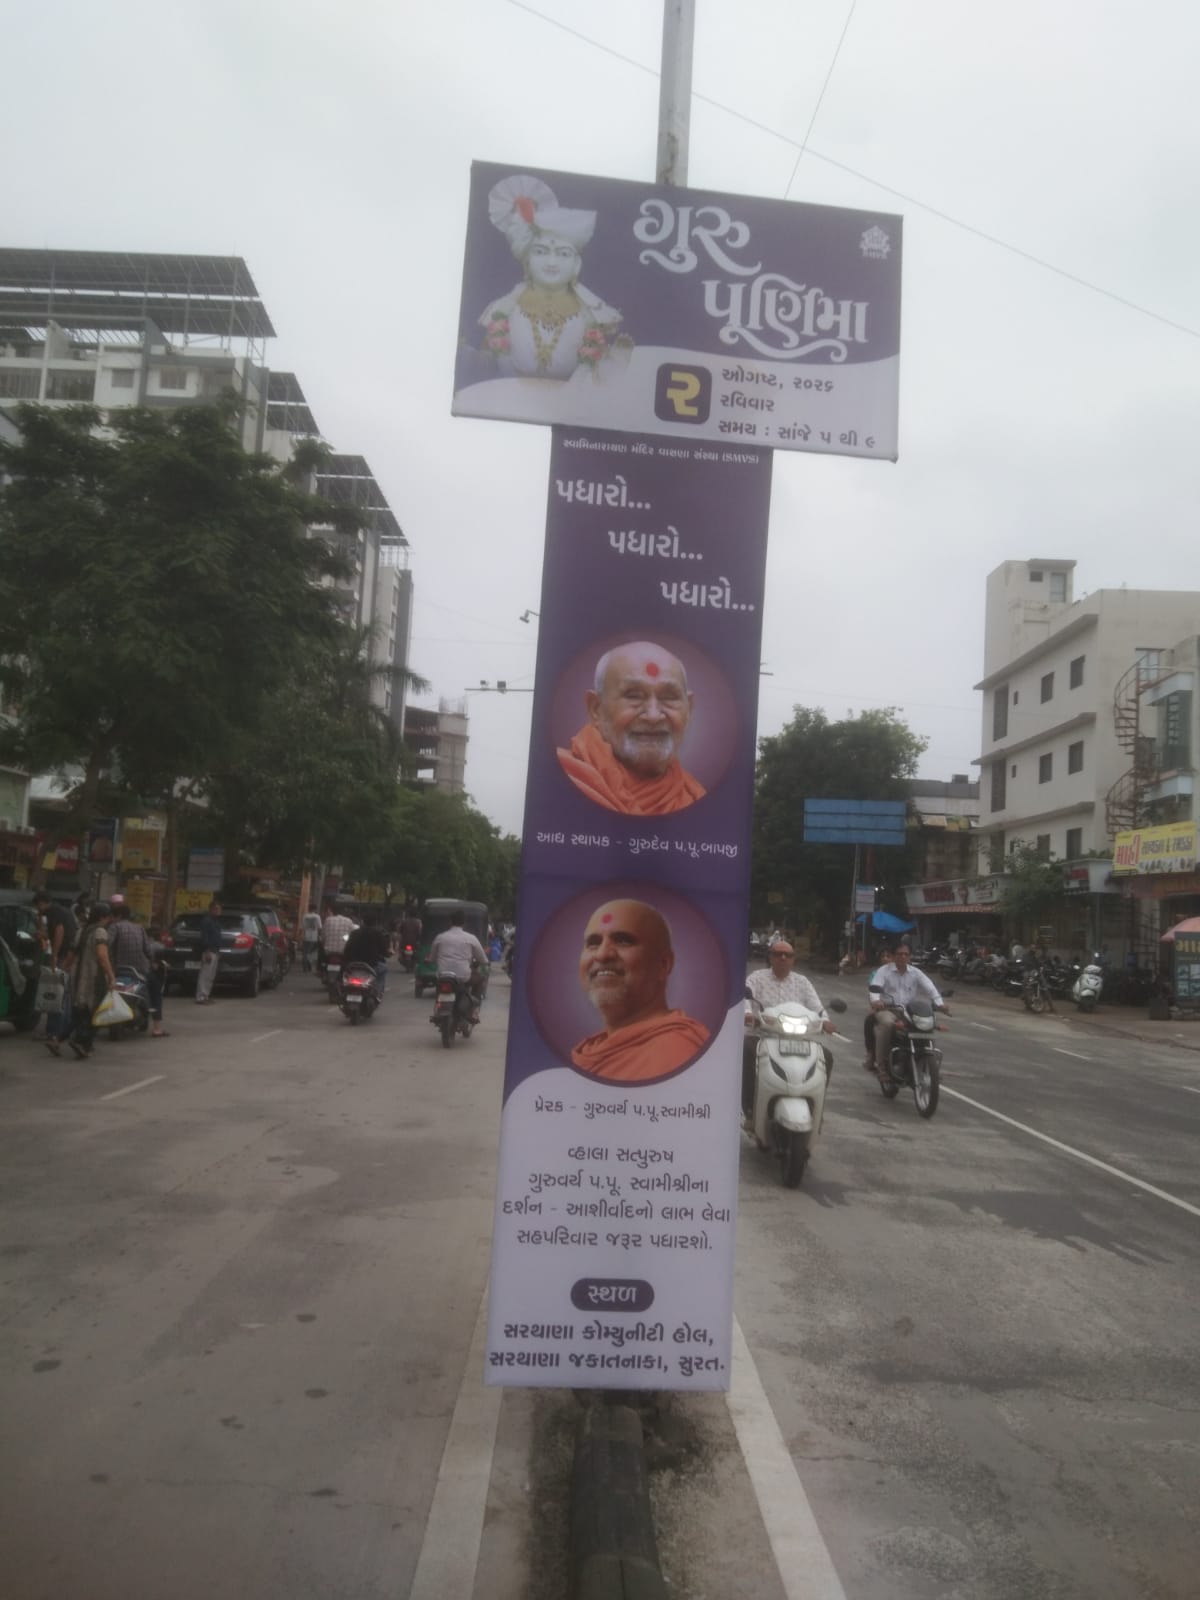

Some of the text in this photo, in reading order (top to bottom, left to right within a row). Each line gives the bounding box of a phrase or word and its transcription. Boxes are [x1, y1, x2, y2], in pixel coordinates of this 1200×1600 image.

[633, 199, 762, 276] ગુરુ
[701, 273, 869, 362] પૂર્ણિમા
[722, 365, 783, 390] ઓગષ્ટ,
[720, 390, 775, 412] રવિવાર
[718, 419, 756, 436] સમય
[777, 422, 811, 441] સાંજે
[839, 430, 857, 446] થી
[628, 835, 669, 854] ગુરુદેવ
[534, 1096, 564, 1113] પ્રેરક
[584, 1099, 629, 1119] ગુરુવર્ય
[568, 1146, 674, 1169] વ્હાલા સત્પુરુષ
[528, 1169, 584, 1193] ગુરુવર્ય
[630, 1173, 709, 1193] સ્વામીશ્રીના
[502, 1196, 542, 1215] દર્શન
[565, 1199, 653, 1219] આશીર્વાદનો
[661, 1206, 694, 1221] લાભ
[702, 1202, 730, 1222] લેવા
[517, 1226, 712, 1250] સહપરિવાર જરૂર પધારશો.
[587, 1285, 637, 1304] સ્થળ
[503, 1319, 714, 1347] સરથાણા કોમ્યુનીટી હોલ,
[489, 1351, 725, 1377] સરથાણા જકાતનાકા, સુરત.
